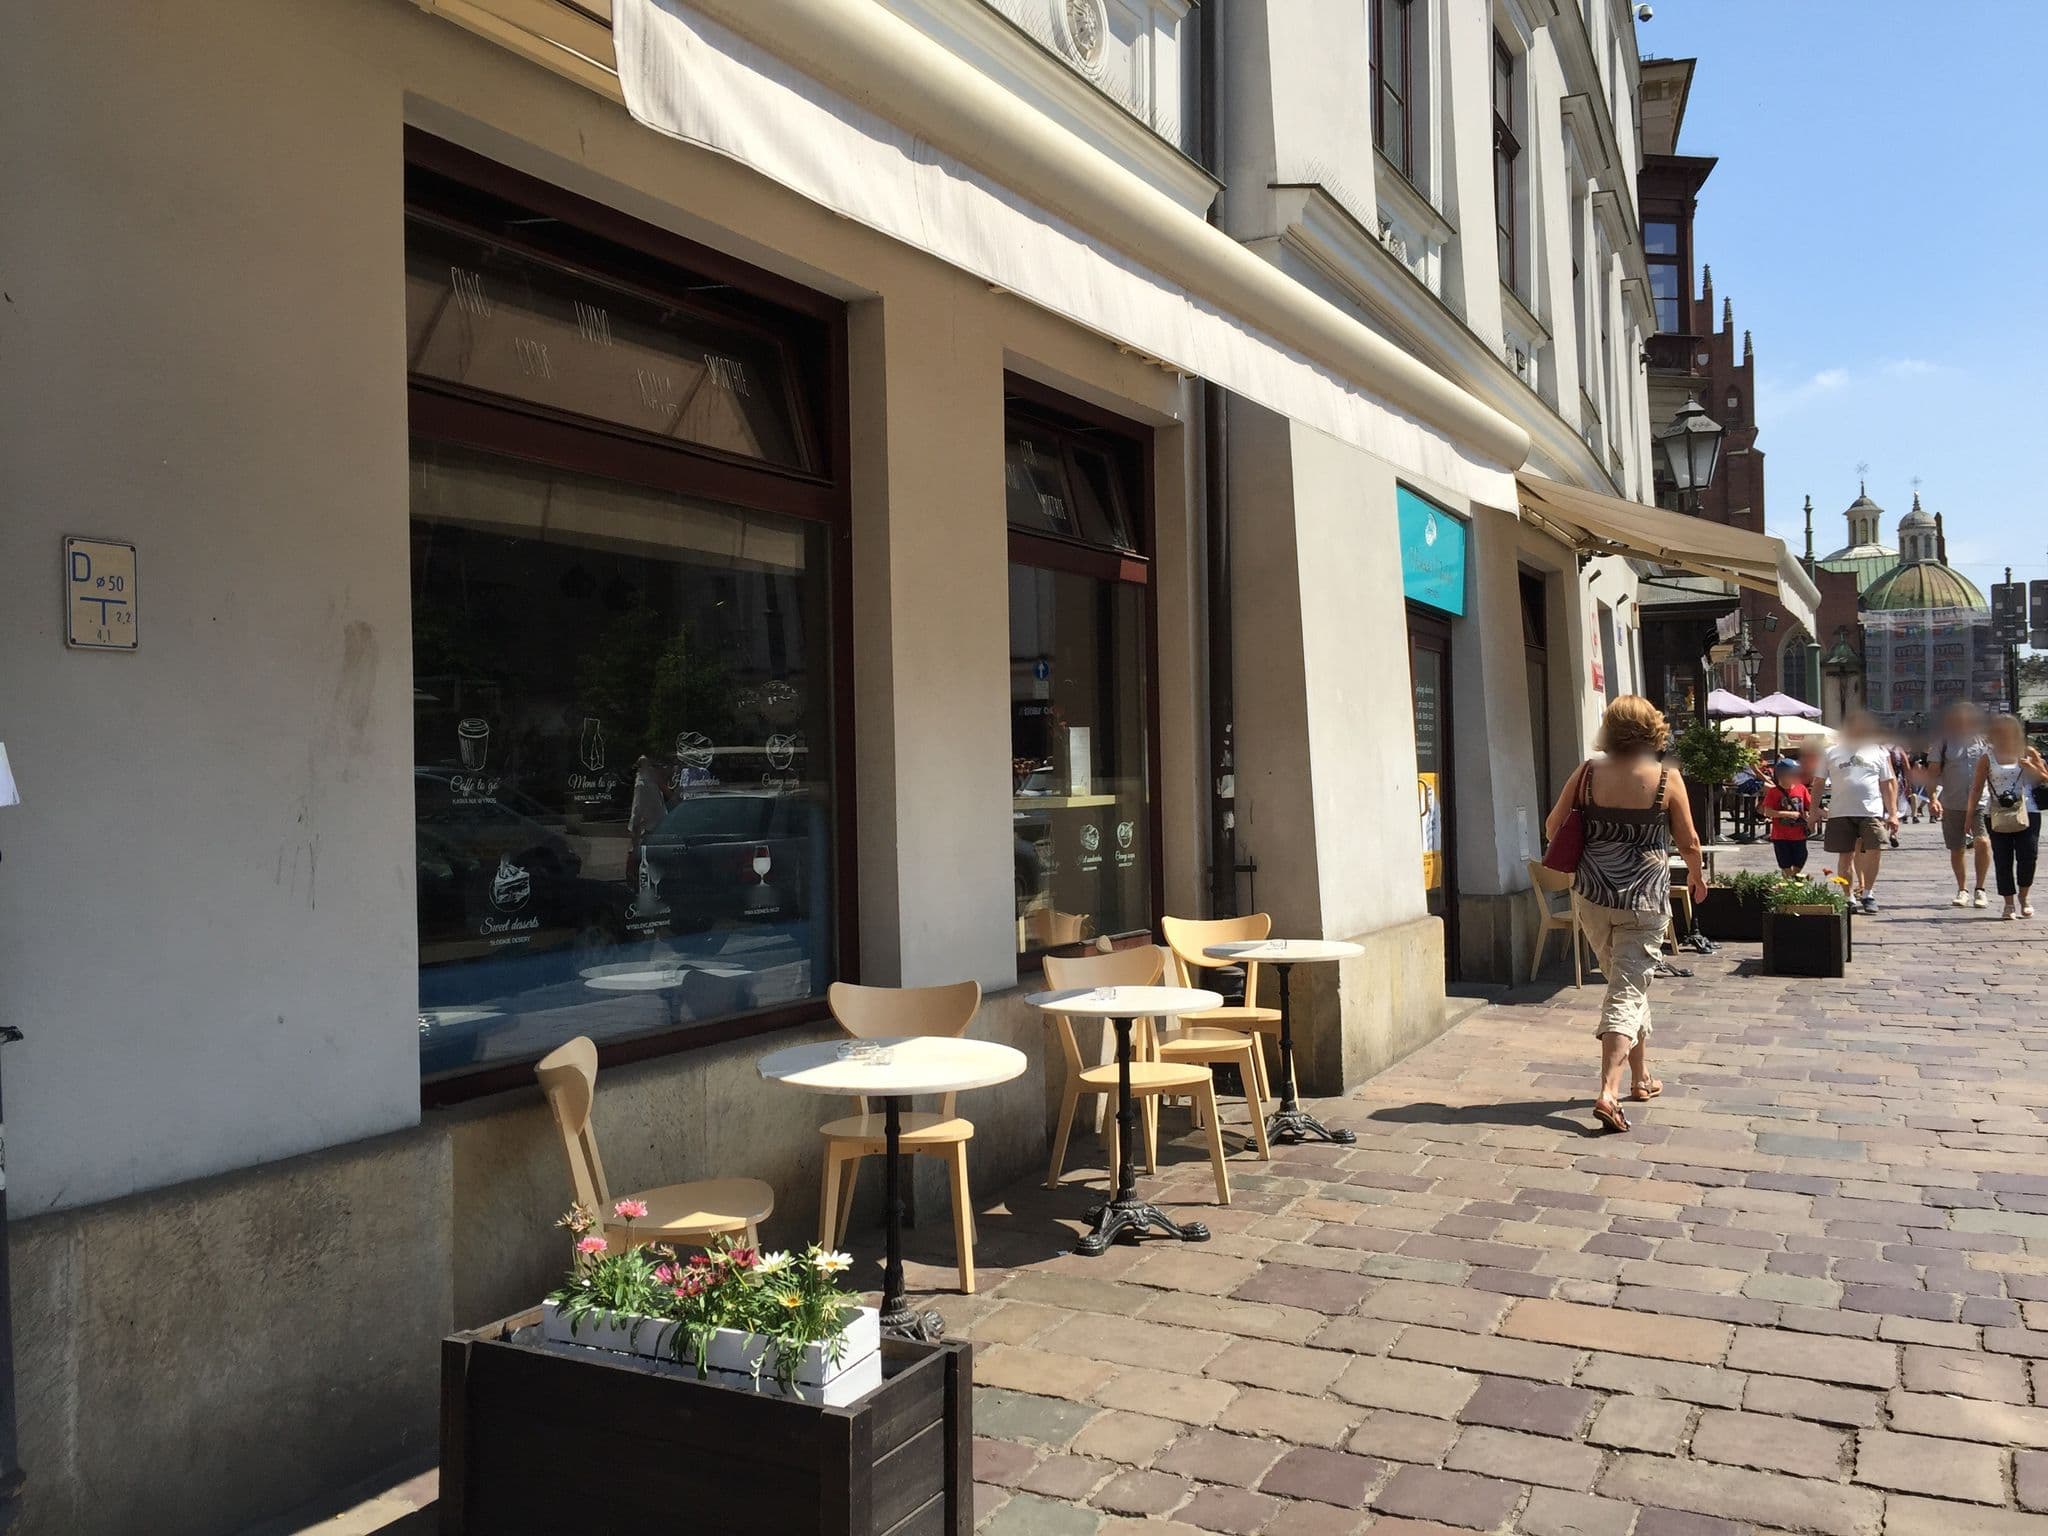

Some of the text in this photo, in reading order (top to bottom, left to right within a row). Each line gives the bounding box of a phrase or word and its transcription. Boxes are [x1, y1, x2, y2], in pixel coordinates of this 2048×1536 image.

[72, 551, 91, 581] D
[477, 778, 486, 790] to
[486, 782, 499, 795] go
[479, 915, 539, 935] Sweet desserts
